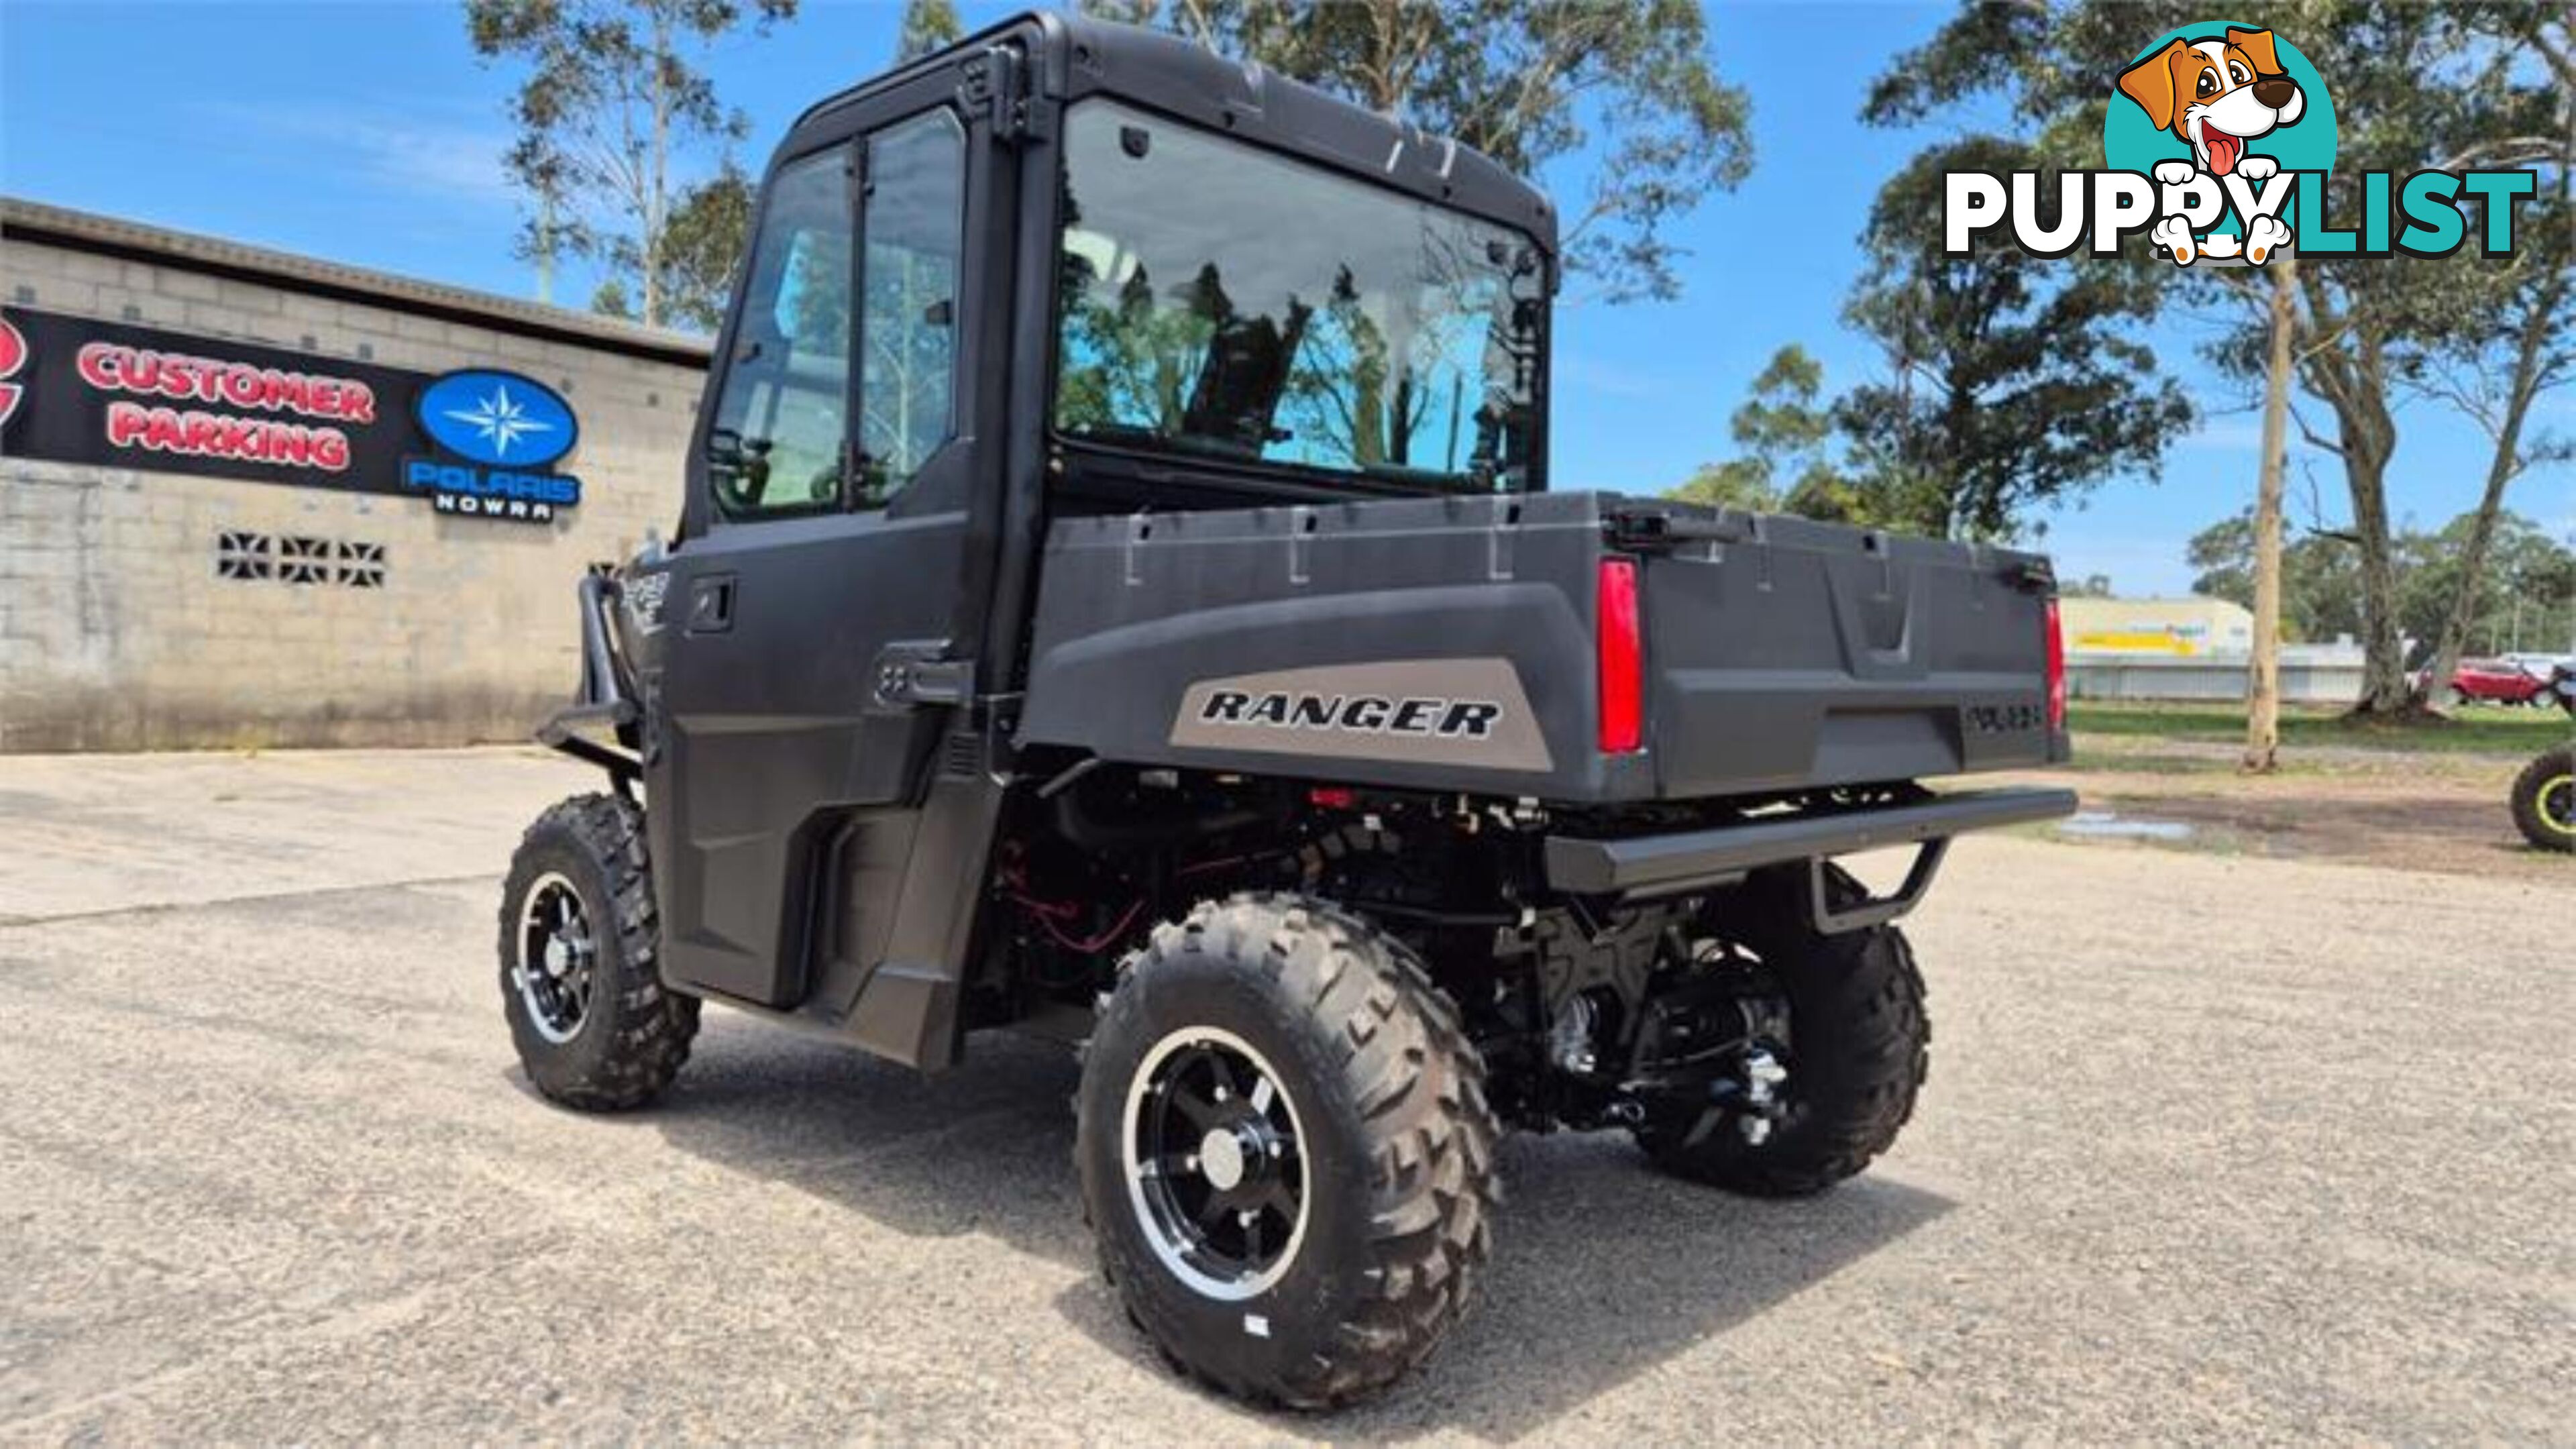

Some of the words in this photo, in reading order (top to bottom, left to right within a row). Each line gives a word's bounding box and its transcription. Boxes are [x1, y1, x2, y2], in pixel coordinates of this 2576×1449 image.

[76, 343, 375, 423] CUSTOMER
[108, 403, 350, 468] PARKING
[408, 462, 577, 502] POLARIS
[436, 495, 551, 519] NOWRA
[1201, 690, 1501, 736] RANGER
